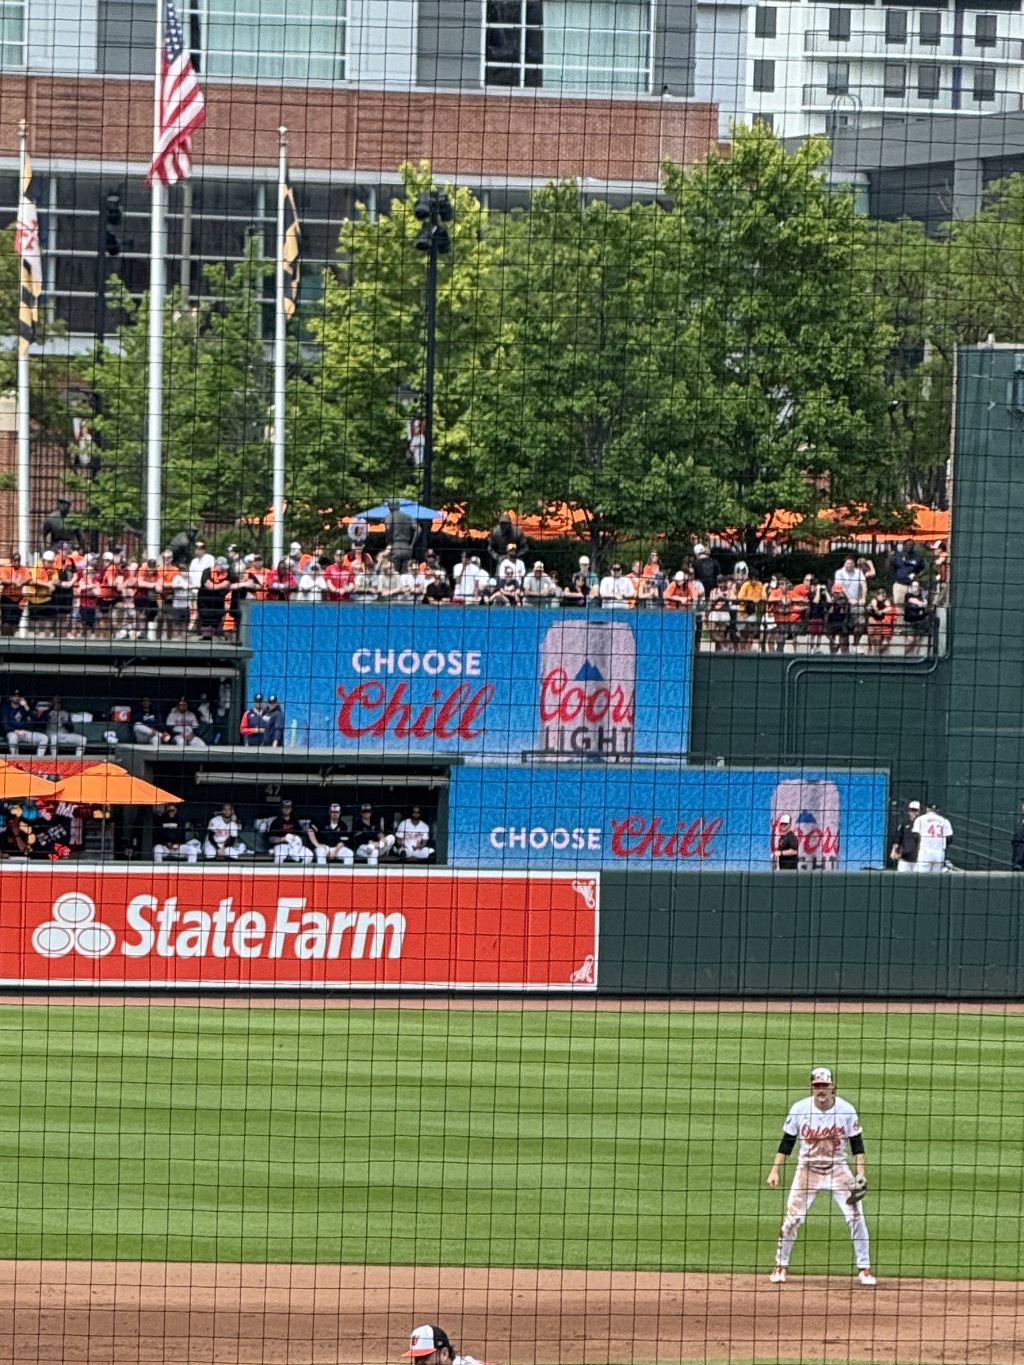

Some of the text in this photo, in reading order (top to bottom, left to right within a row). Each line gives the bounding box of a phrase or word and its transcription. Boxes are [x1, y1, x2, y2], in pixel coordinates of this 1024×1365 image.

[351, 648, 482, 676] CHOOSE
[336, 680, 496, 740] Chill
[490, 815, 724, 858] CHOOSE Chill
[927, 824, 944, 837] 43
